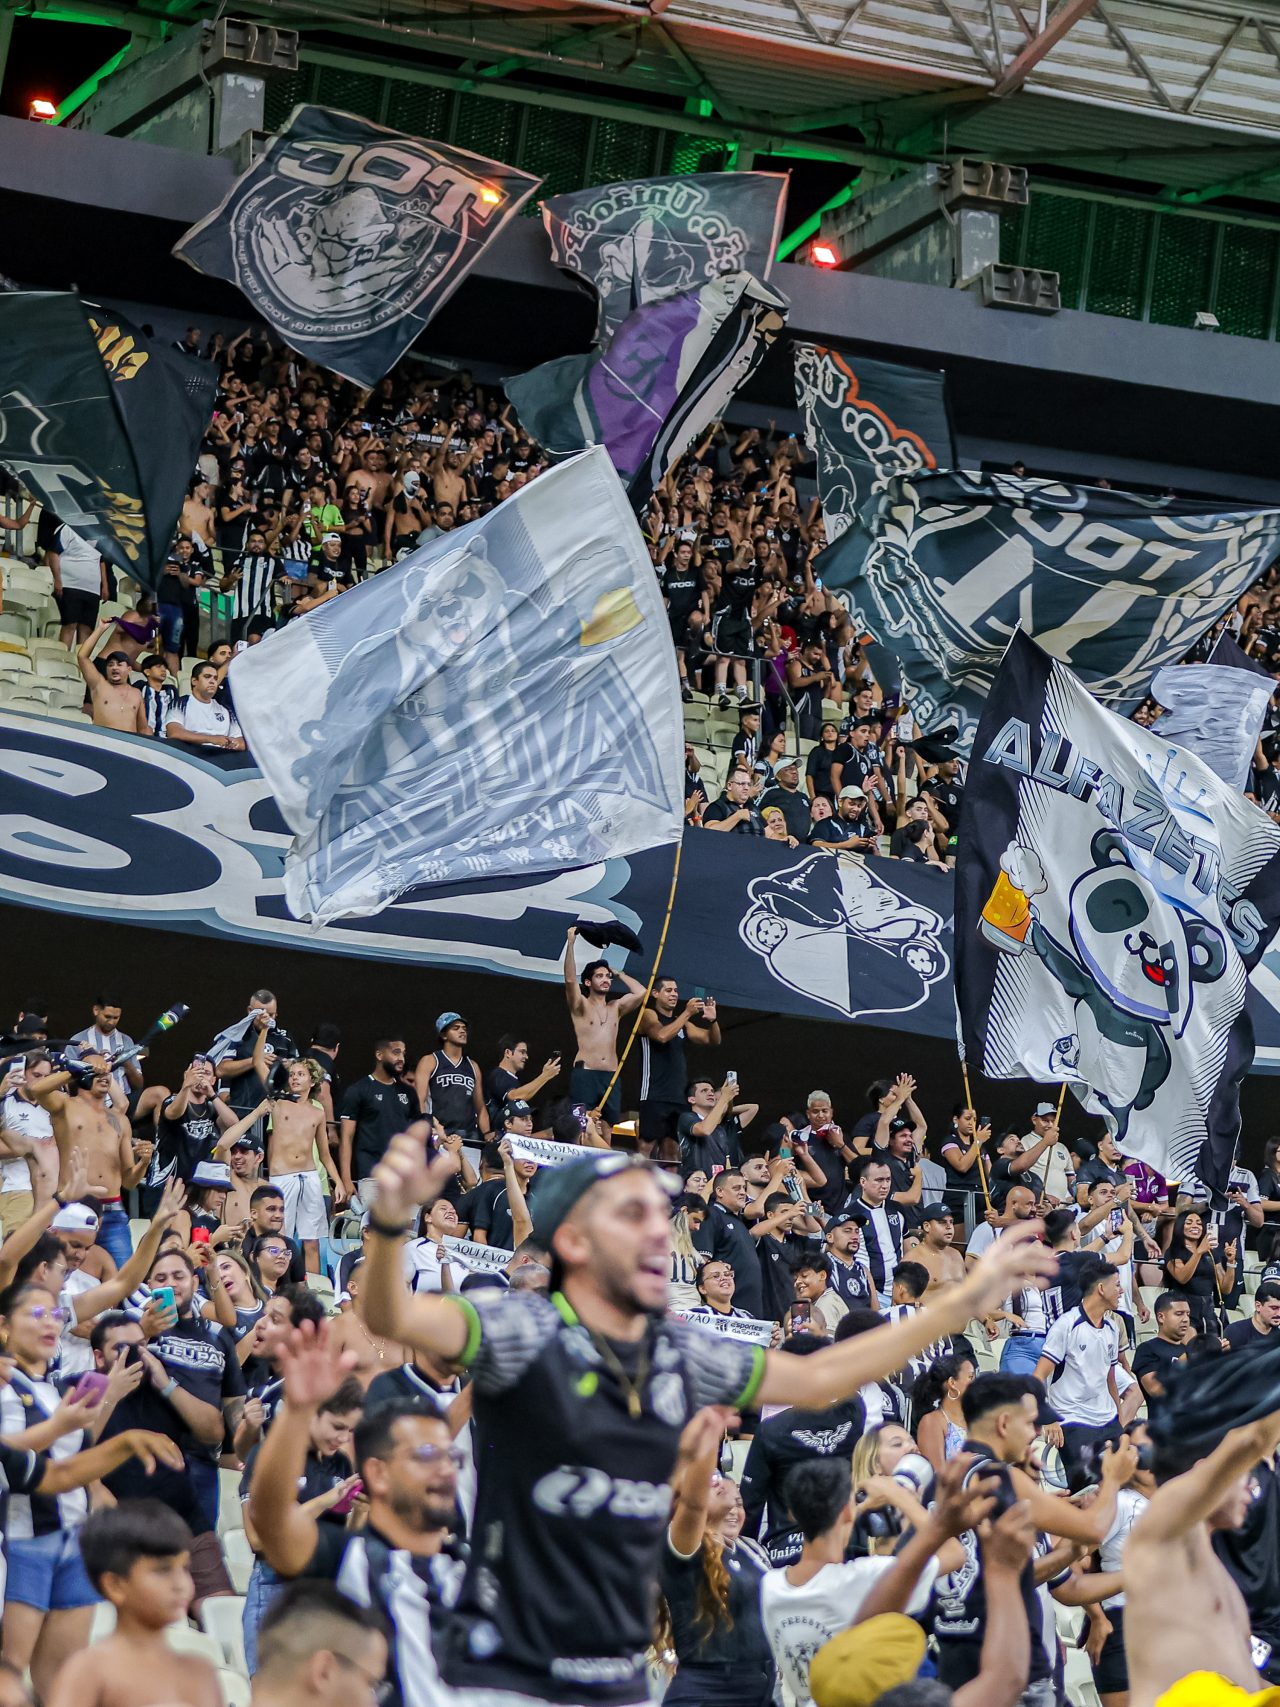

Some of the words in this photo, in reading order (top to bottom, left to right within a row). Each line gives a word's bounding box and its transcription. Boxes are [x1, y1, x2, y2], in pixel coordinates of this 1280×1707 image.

[436, 1073, 476, 1089] TOC
[517, 1138, 542, 1151] AQUI
[452, 1242, 480, 1258] AQUI
[491, 1251, 512, 1264] VOZ
[680, 1311, 711, 1325] OZÃO
[162, 1343, 195, 1360] TEU
[770, 1544, 803, 1560] União
